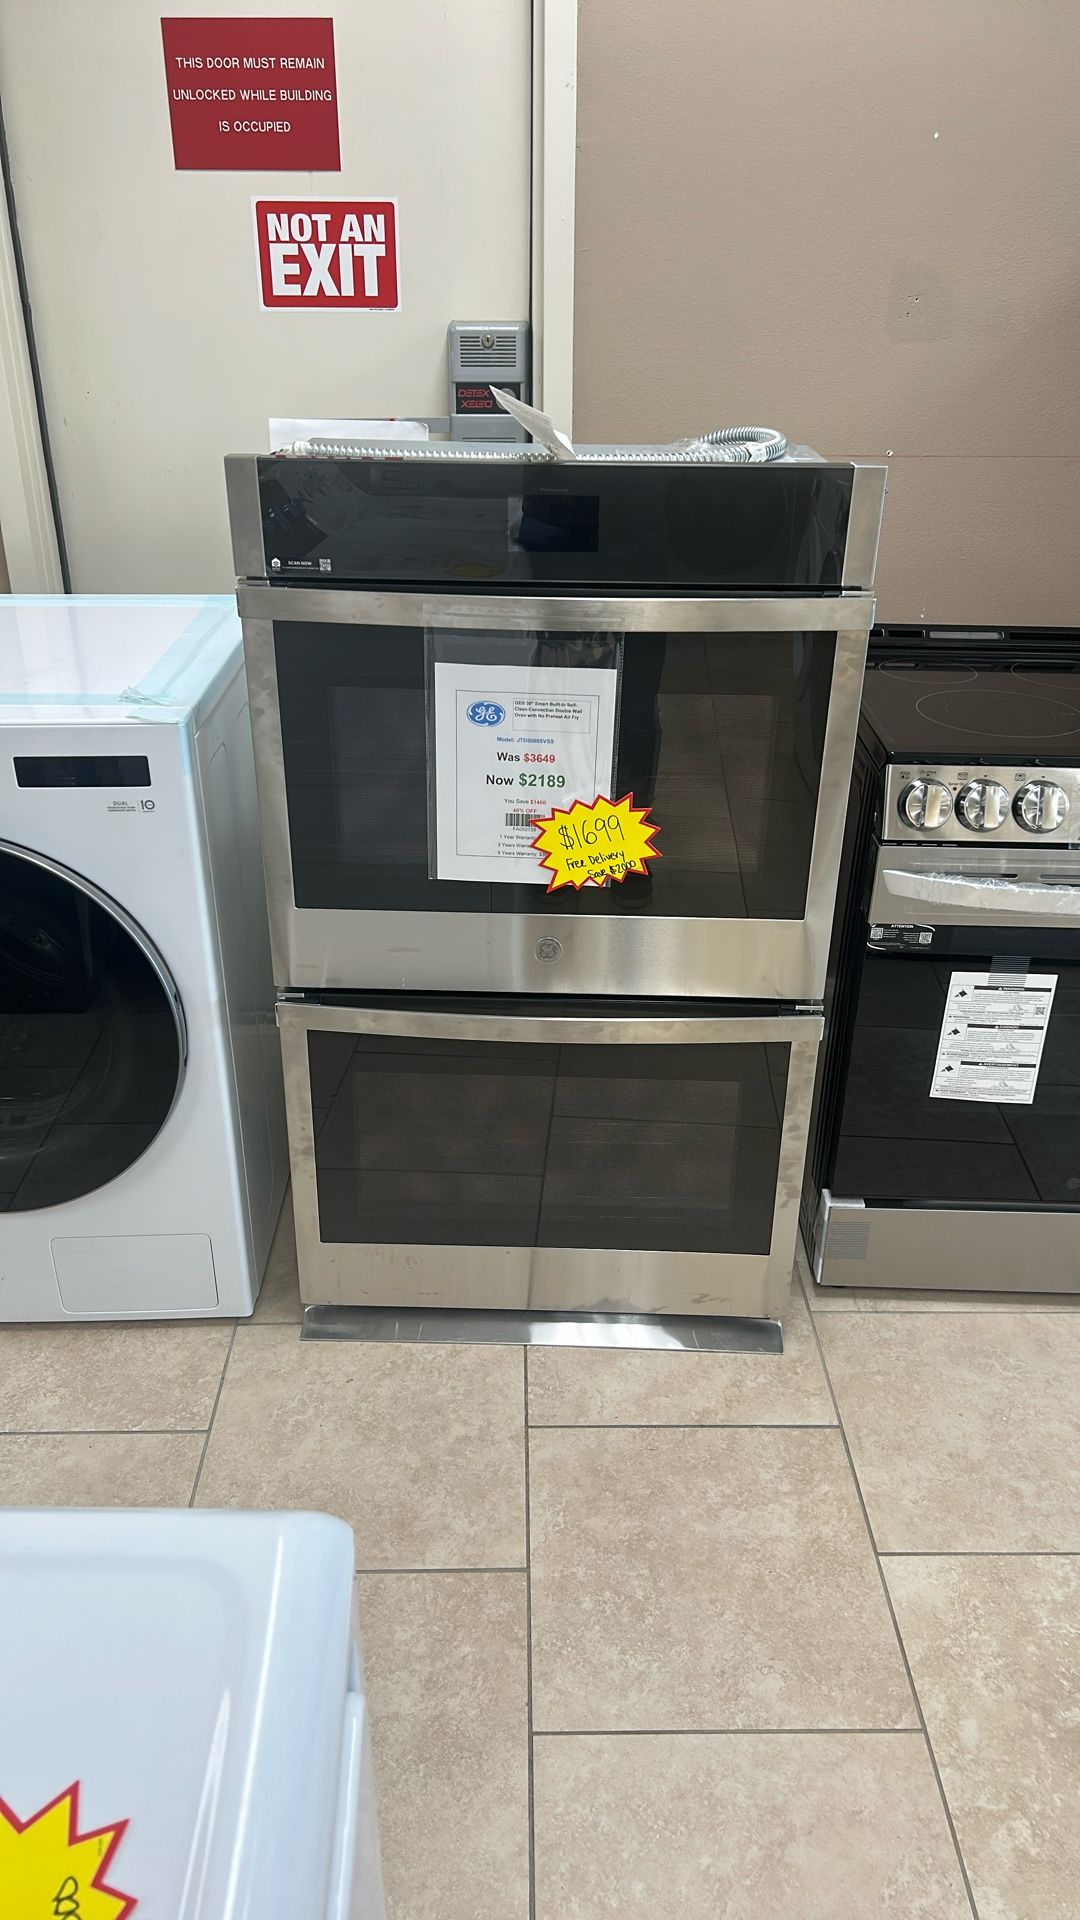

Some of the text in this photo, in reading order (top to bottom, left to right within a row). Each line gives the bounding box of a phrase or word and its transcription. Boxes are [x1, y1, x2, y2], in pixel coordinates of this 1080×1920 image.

[175, 57, 325, 69] THIS DOOR MUST REMAIN
[172, 89, 332, 101] UNLOCKED WHILE BUILDING
[218, 120, 291, 133] IS OCCUPIED
[266, 212, 386, 243] NOT AN
[268, 242, 387, 297] EXIT
[457, 389, 491, 398] DETEX
[496, 751, 556, 764] Was $3649
[485, 772, 566, 788] Now $2189
[558, 814, 625, 850] $1699
[565, 850, 626, 871] Free Delivery
[587, 859, 637, 879] Save $2000
